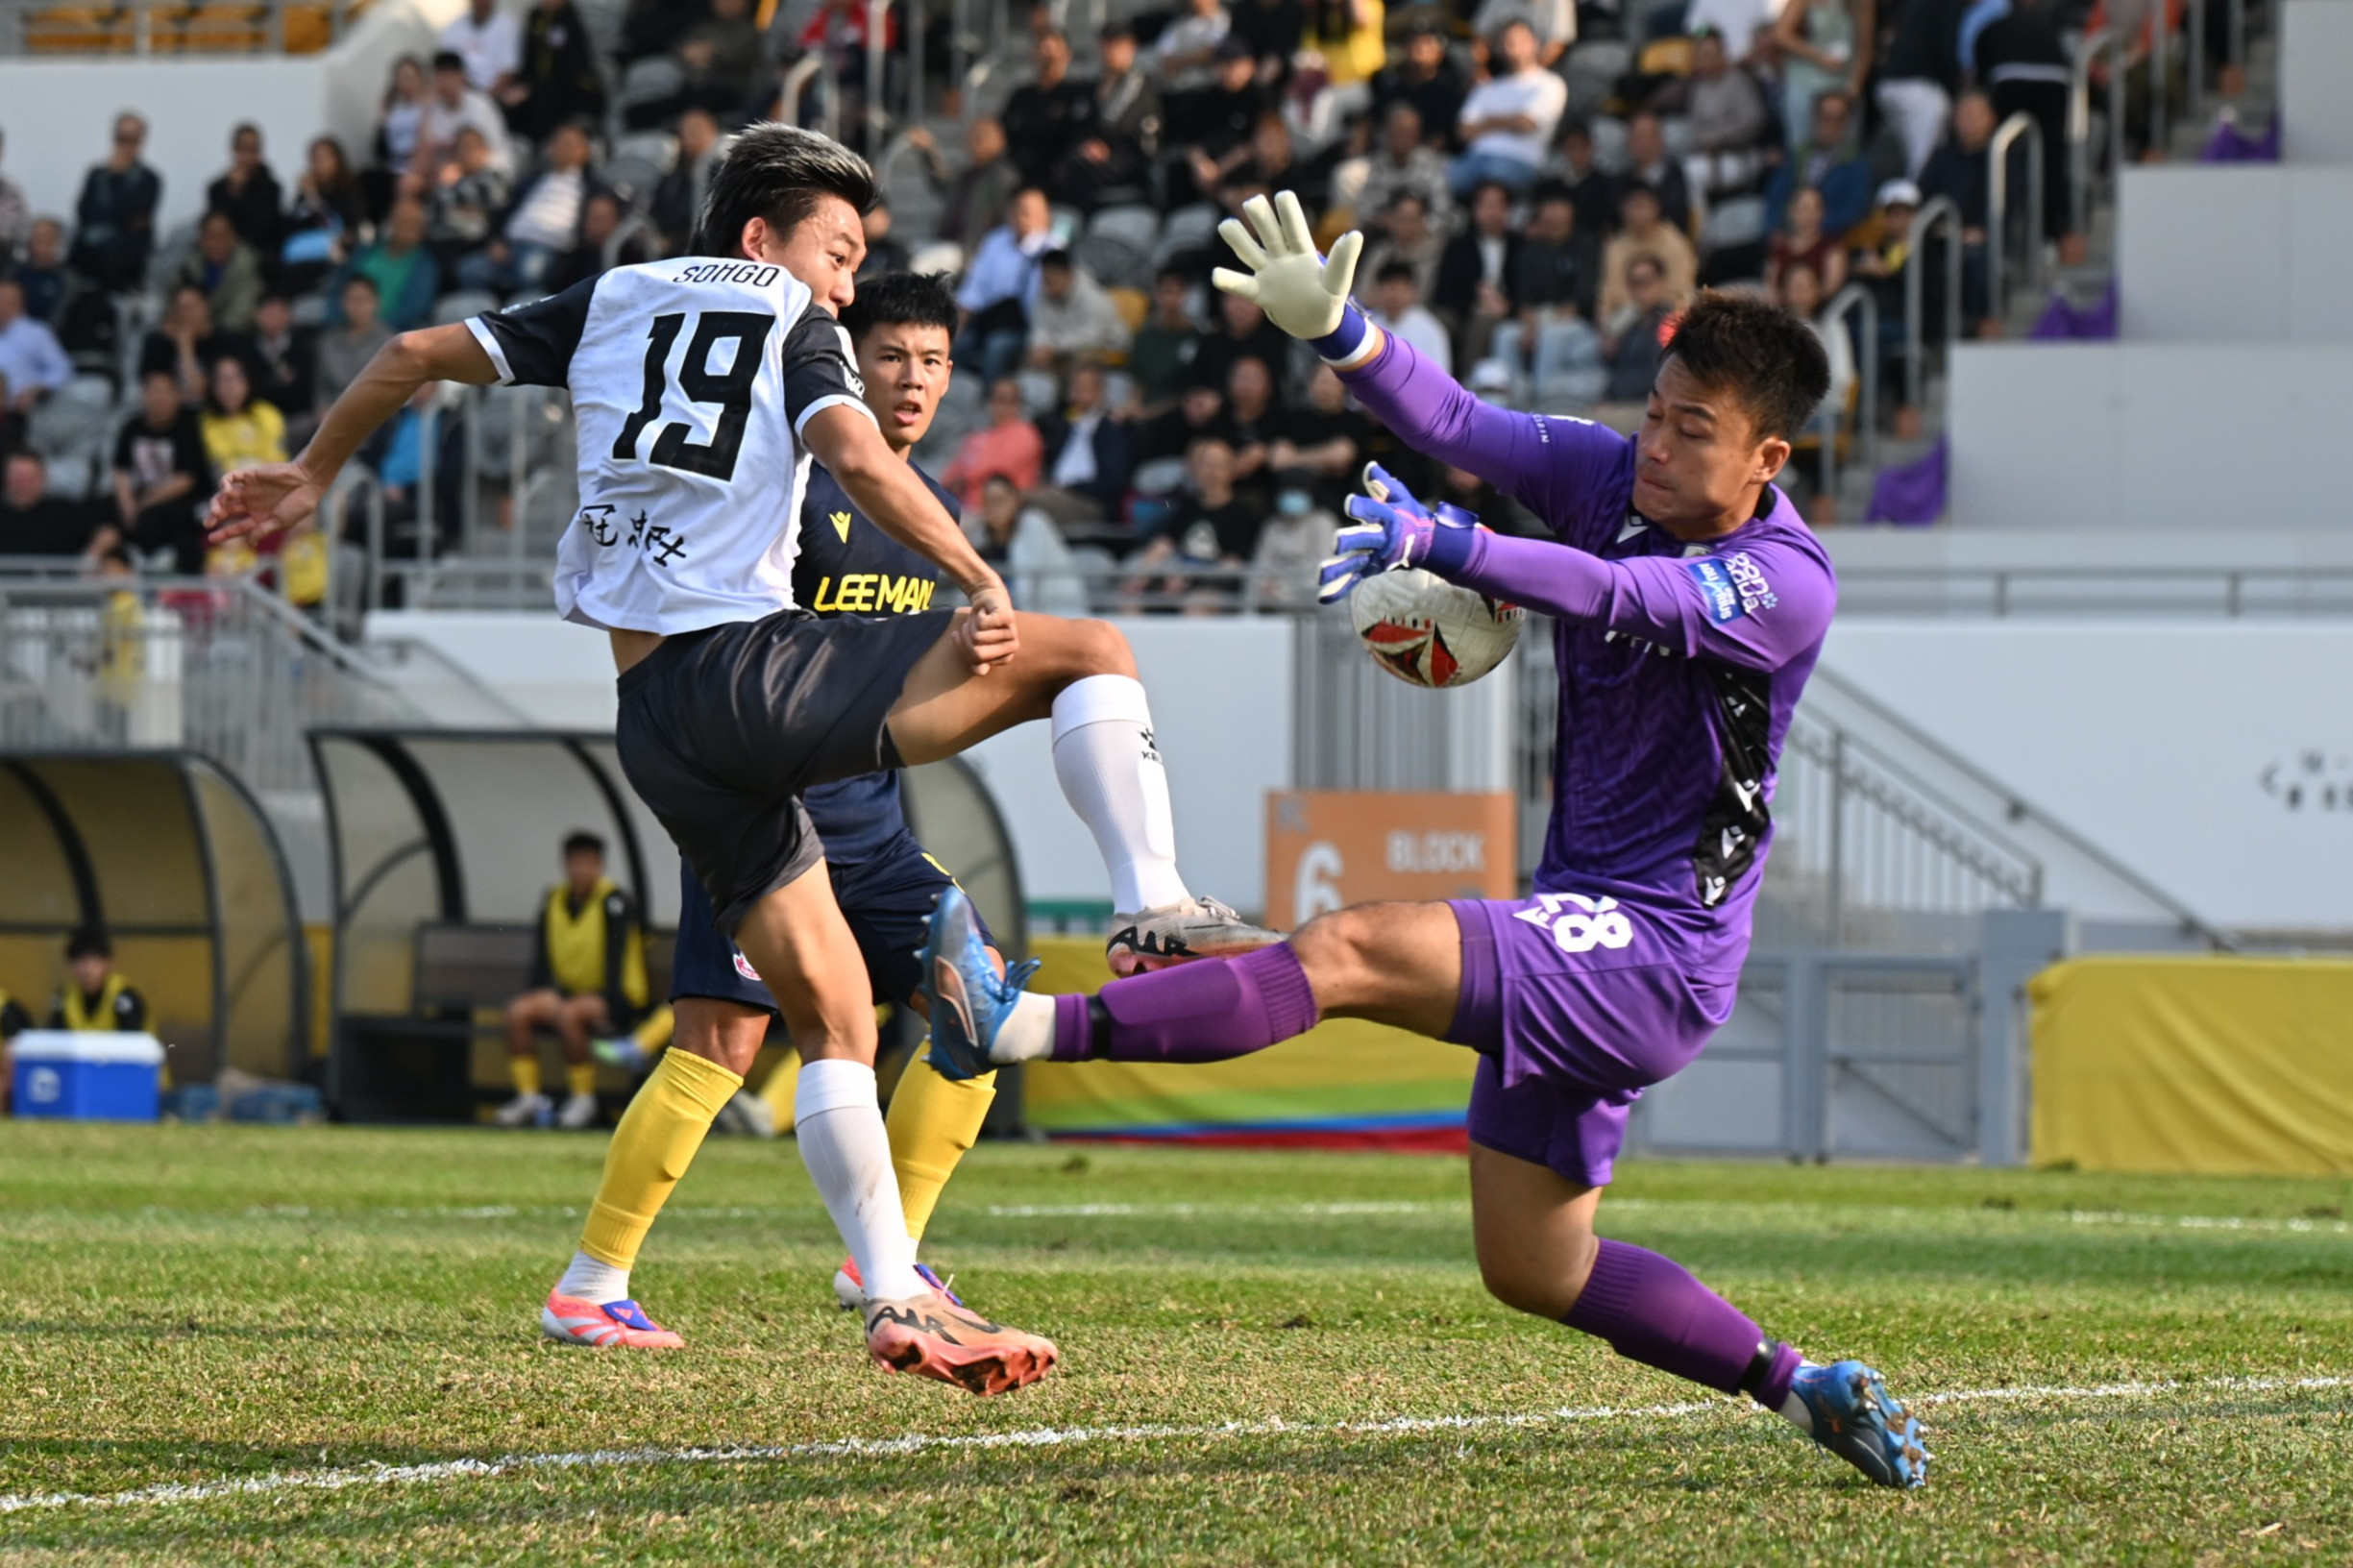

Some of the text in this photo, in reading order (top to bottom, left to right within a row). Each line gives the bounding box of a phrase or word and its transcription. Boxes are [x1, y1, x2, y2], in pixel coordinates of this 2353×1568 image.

[611, 310, 776, 482] 19
[1697, 562, 1733, 620] AQUARIUS
[1385, 829, 1486, 872] BLOCK
[1293, 841, 1344, 927] 6
[1537, 893, 1633, 953] 28
